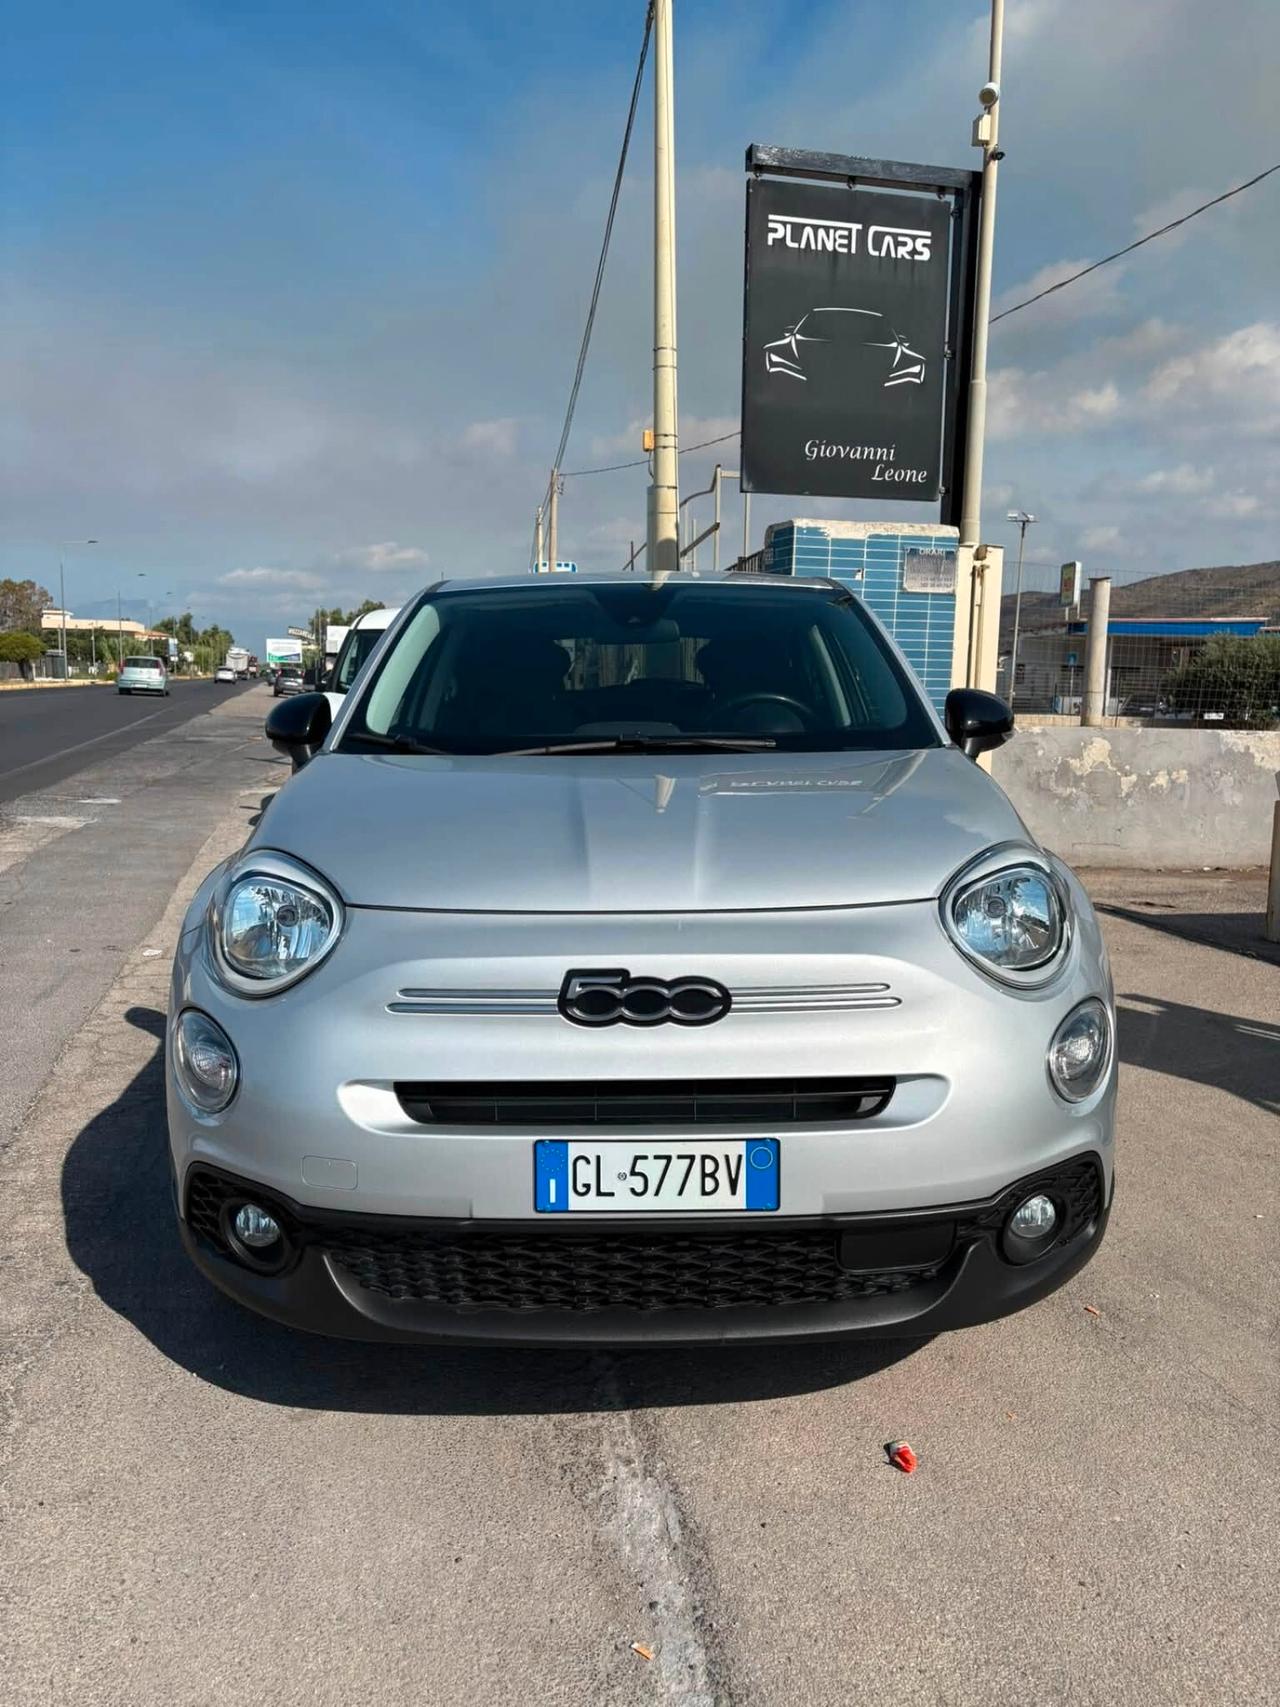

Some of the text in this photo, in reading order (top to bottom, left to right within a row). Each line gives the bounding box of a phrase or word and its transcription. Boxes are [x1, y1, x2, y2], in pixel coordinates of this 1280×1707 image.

[767, 214, 932, 261] PLANET CARS
[804, 439, 896, 461] Giovanni
[871, 463, 928, 483] Leone
[558, 968, 732, 1027] 500
